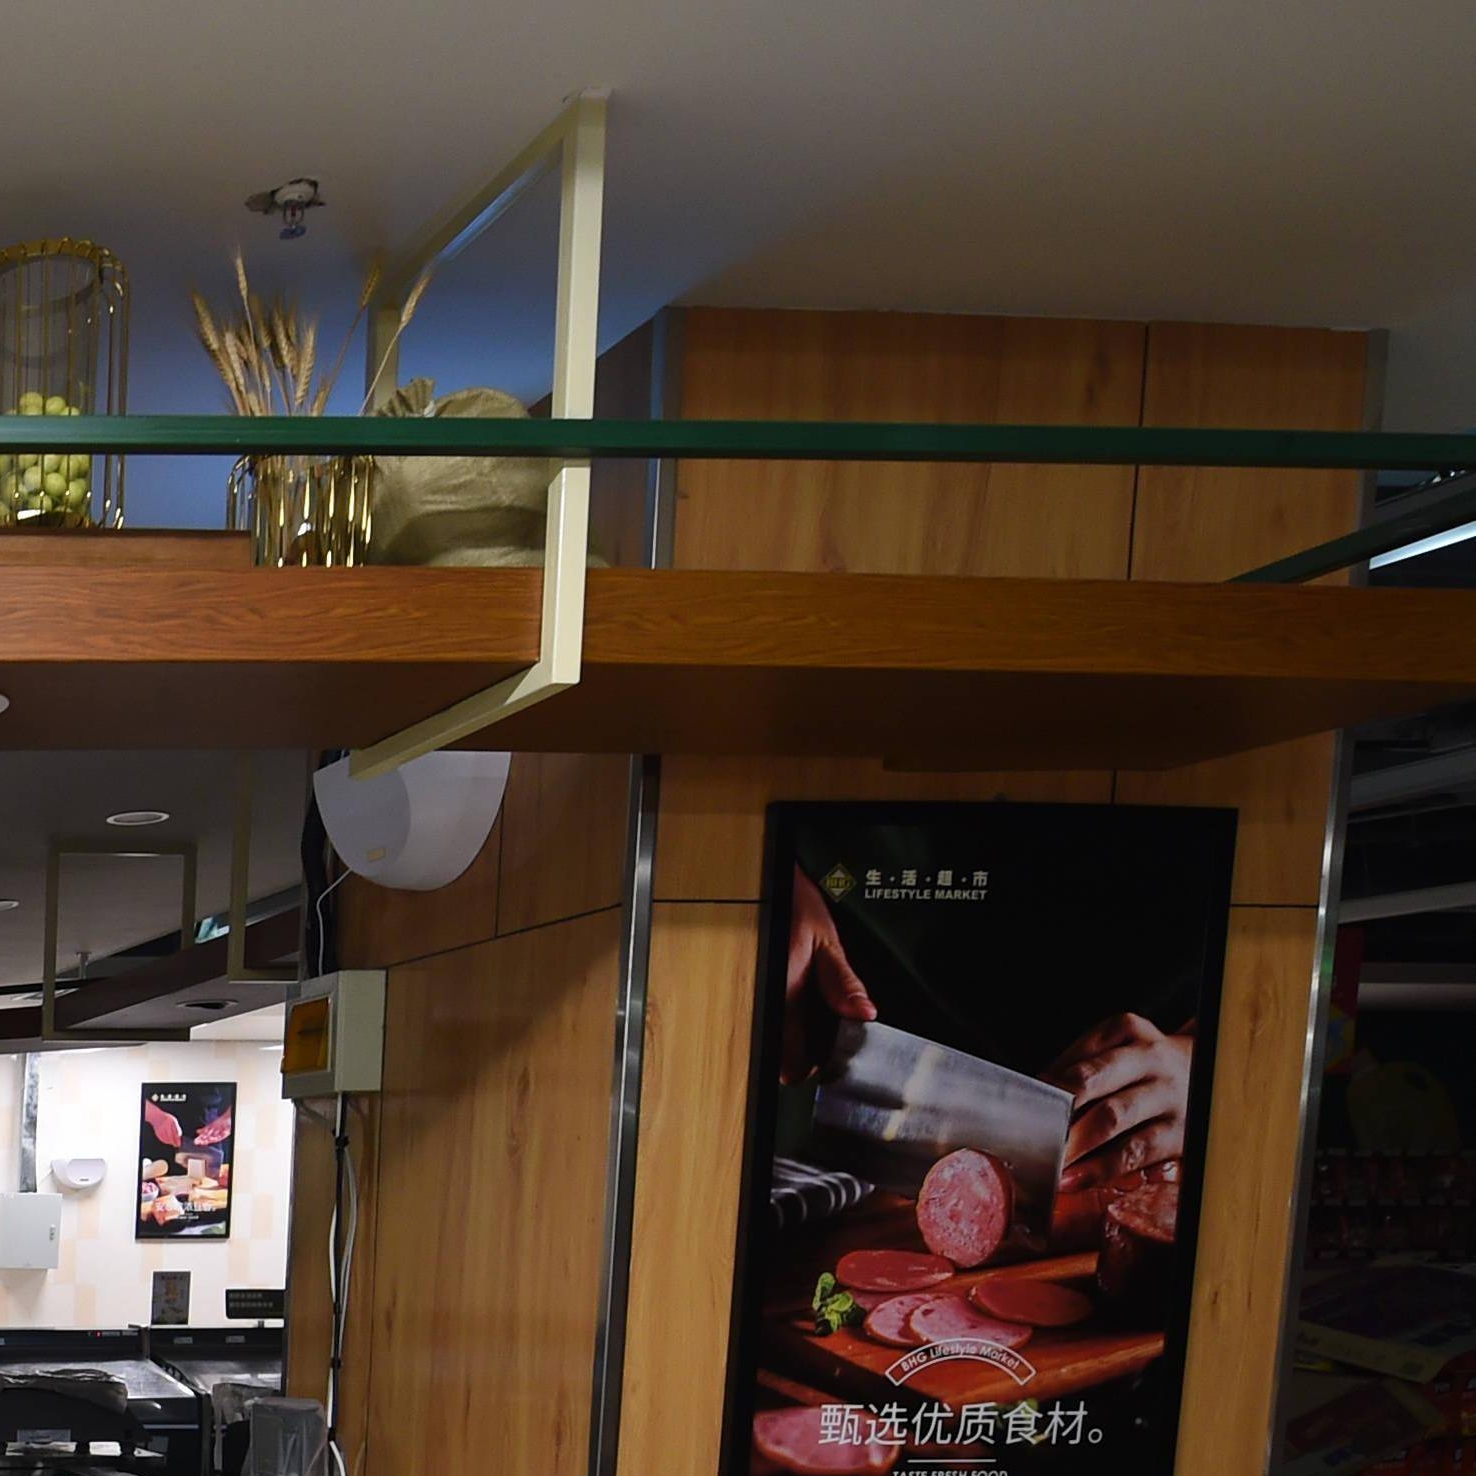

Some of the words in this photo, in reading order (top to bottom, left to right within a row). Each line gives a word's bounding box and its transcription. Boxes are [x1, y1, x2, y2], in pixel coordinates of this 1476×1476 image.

[864, 889, 932, 901] LIFESTYLE
[934, 889, 988, 901] MARKET
[901, 1350, 928, 1373] BHG
[818, 1400, 1104, 1447] 甄选优质食材。
